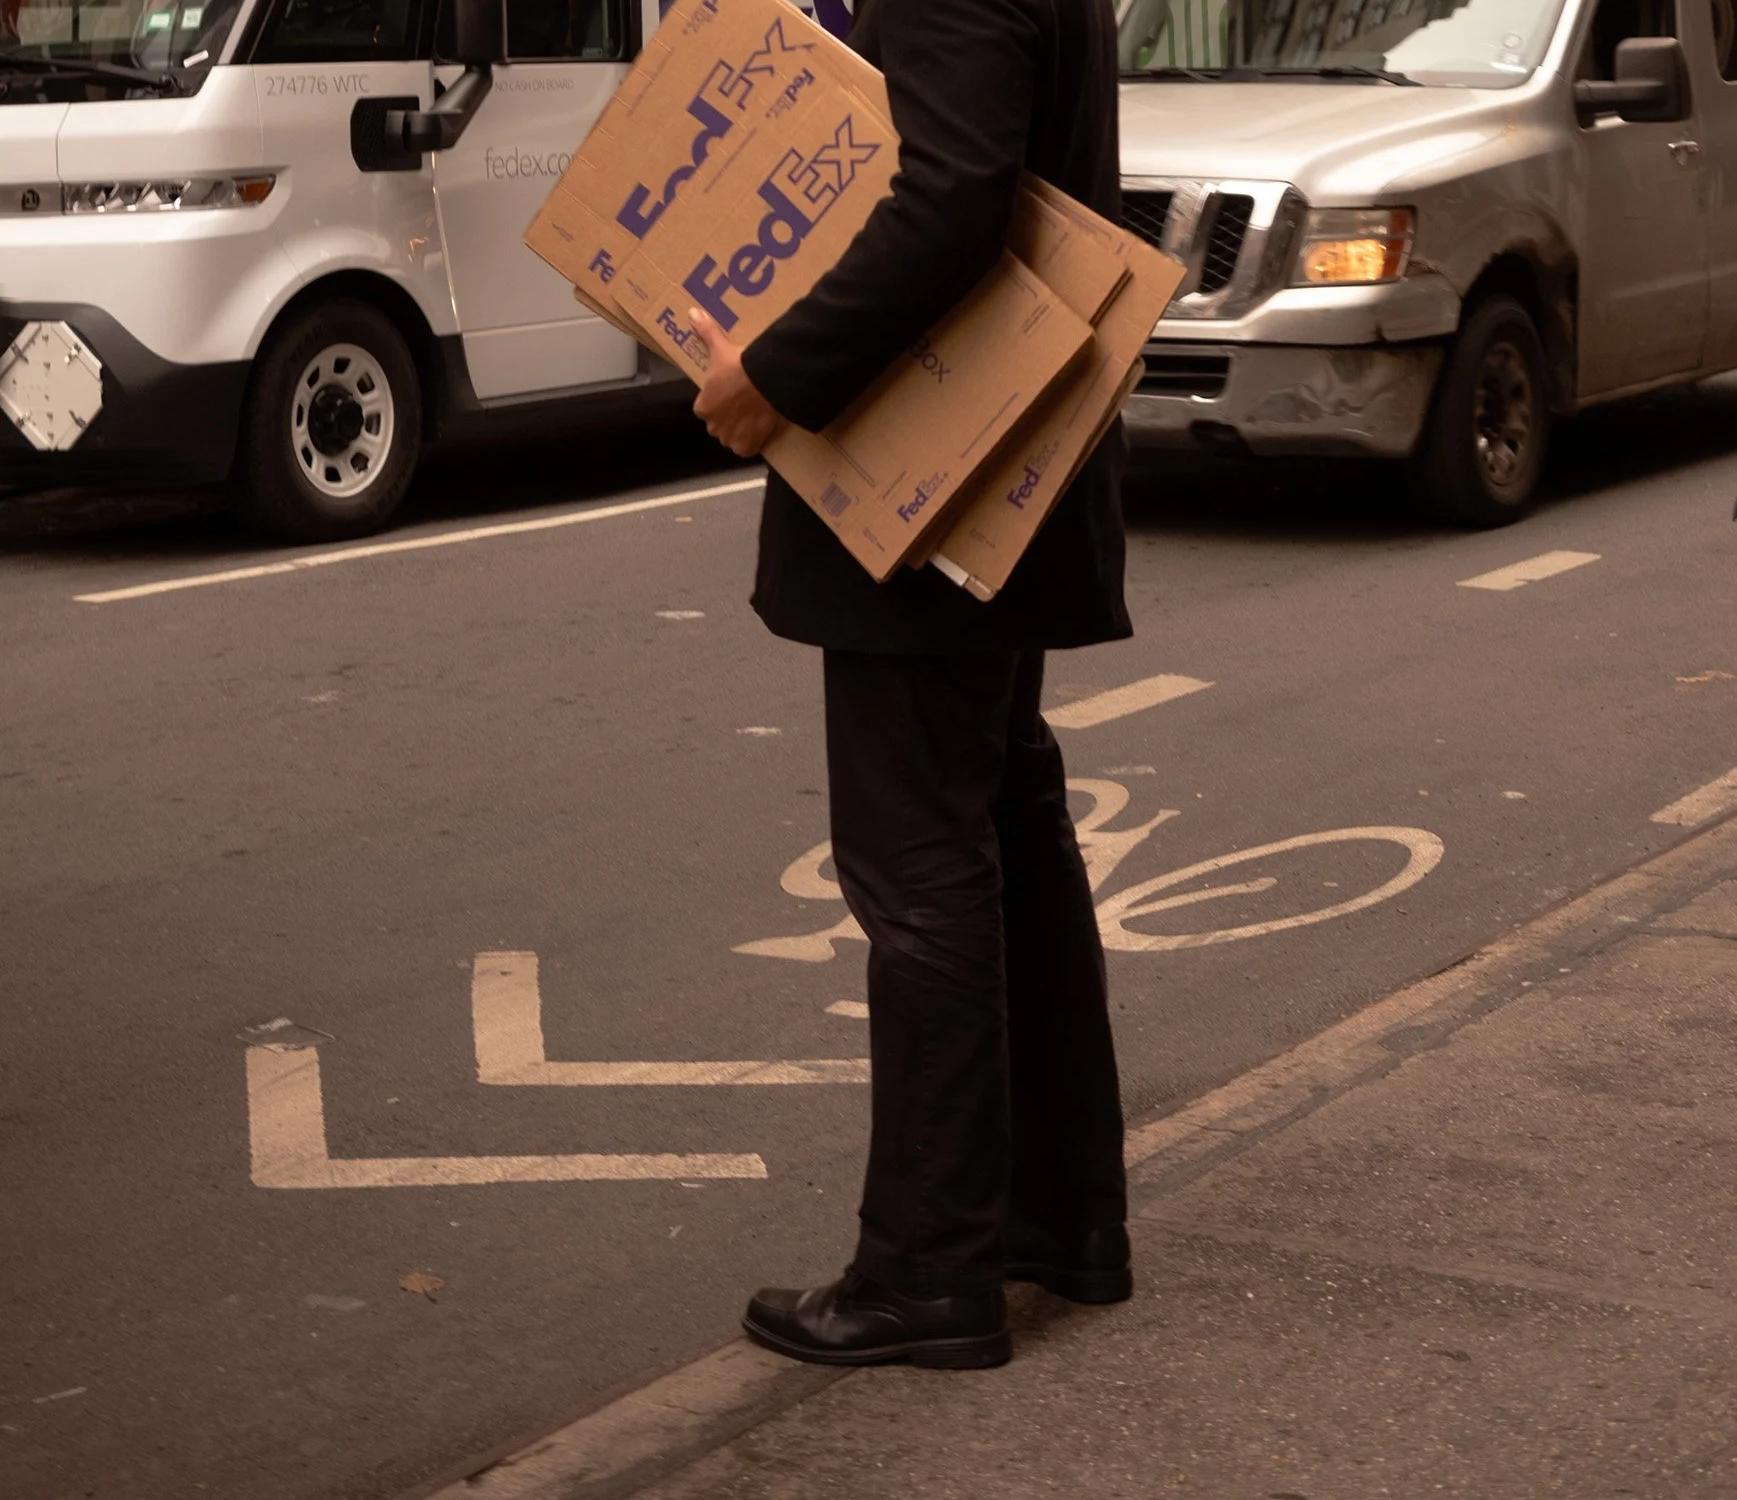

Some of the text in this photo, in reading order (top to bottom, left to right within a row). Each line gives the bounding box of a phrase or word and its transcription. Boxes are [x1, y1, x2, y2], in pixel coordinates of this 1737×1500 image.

[264, 73, 370, 96] 274776 WTC
[484, 146, 574, 179] fedex.co
[681, 112, 883, 333] FedEx
